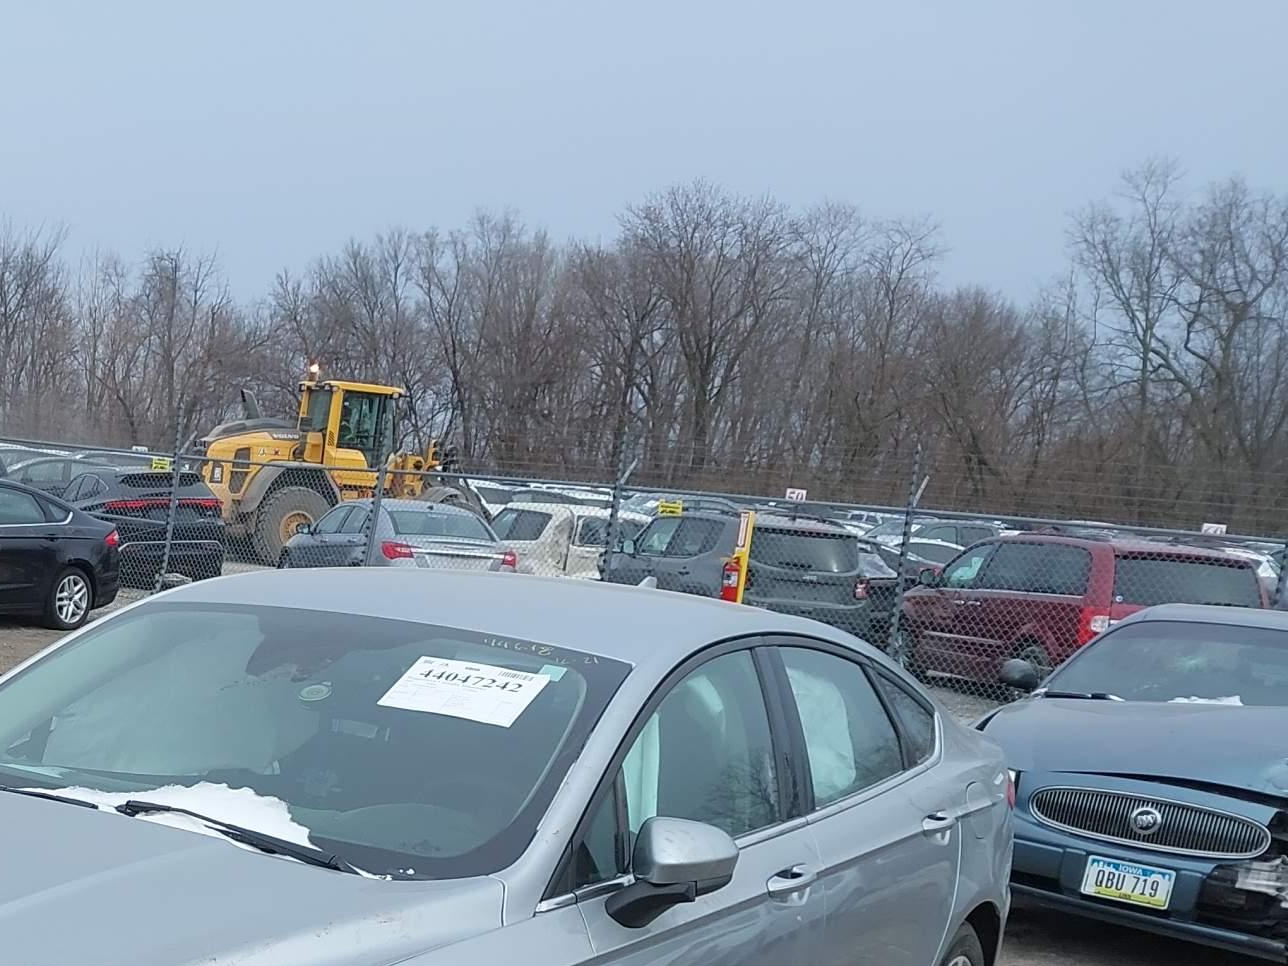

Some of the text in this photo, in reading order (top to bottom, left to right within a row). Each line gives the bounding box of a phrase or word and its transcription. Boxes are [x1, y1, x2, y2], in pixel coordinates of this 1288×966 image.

[420, 668, 523, 693] 44047242
[1119, 864, 1144, 876] IOWA
[1095, 869, 1160, 898] QBU 719
